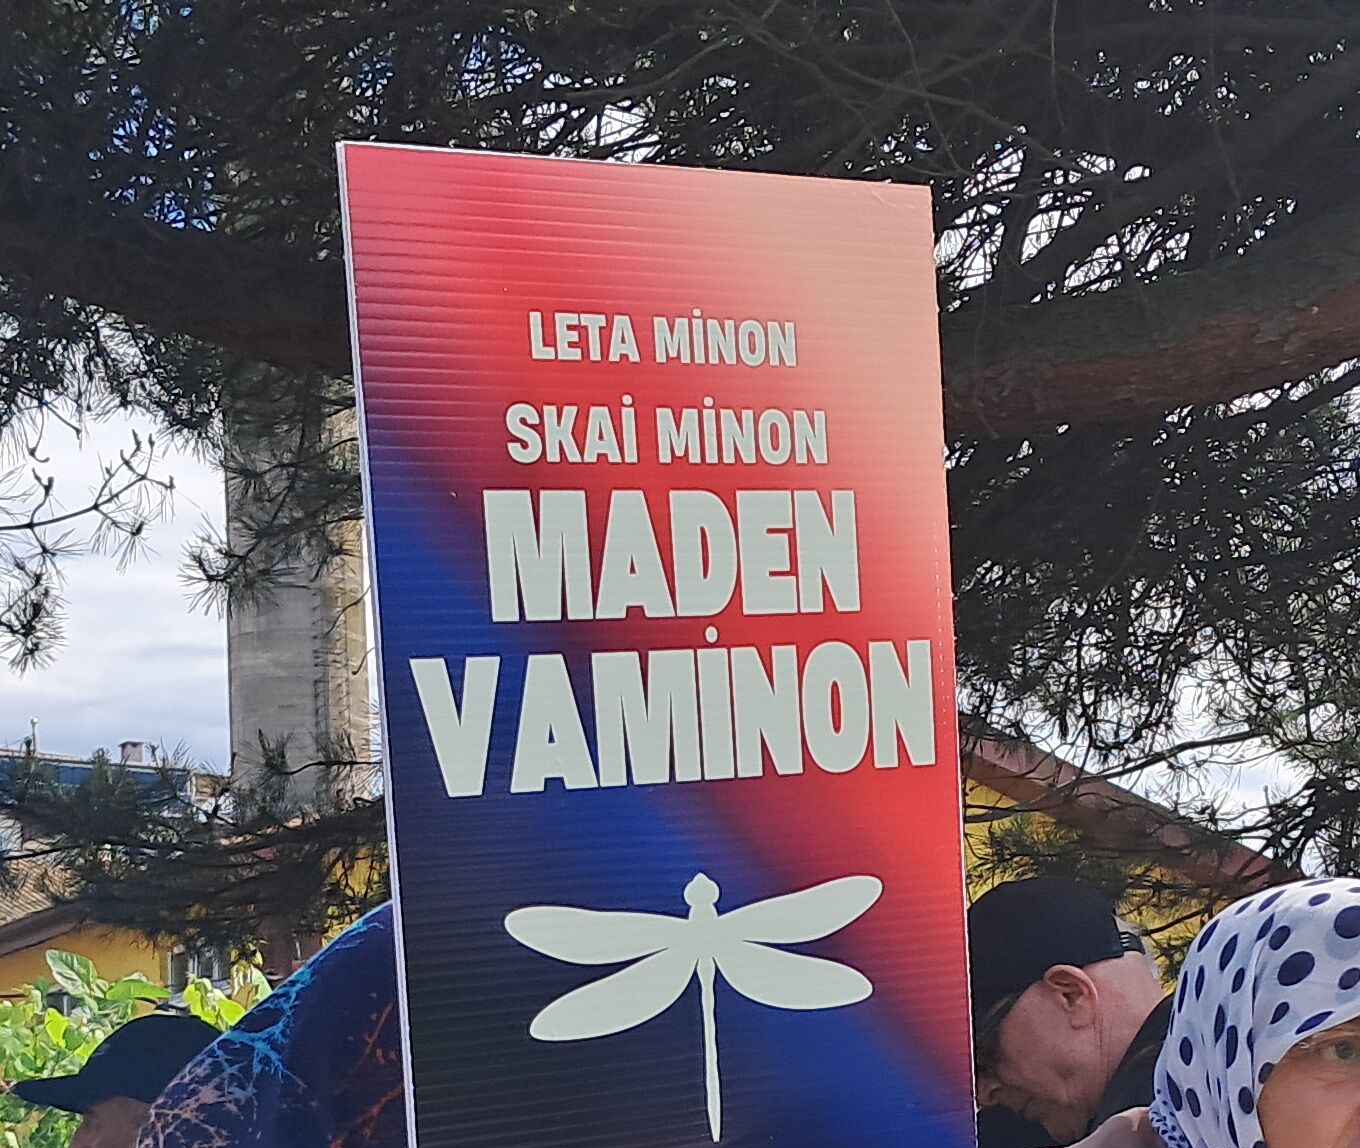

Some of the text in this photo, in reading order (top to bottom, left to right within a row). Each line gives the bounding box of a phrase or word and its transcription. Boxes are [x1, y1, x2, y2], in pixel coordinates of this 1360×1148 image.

[528, 307, 797, 367] LETA MİNON
[505, 394, 828, 464] SKAİ MİNON
[482, 490, 861, 622] MADEN
[409, 625, 936, 798] VAMİNON
